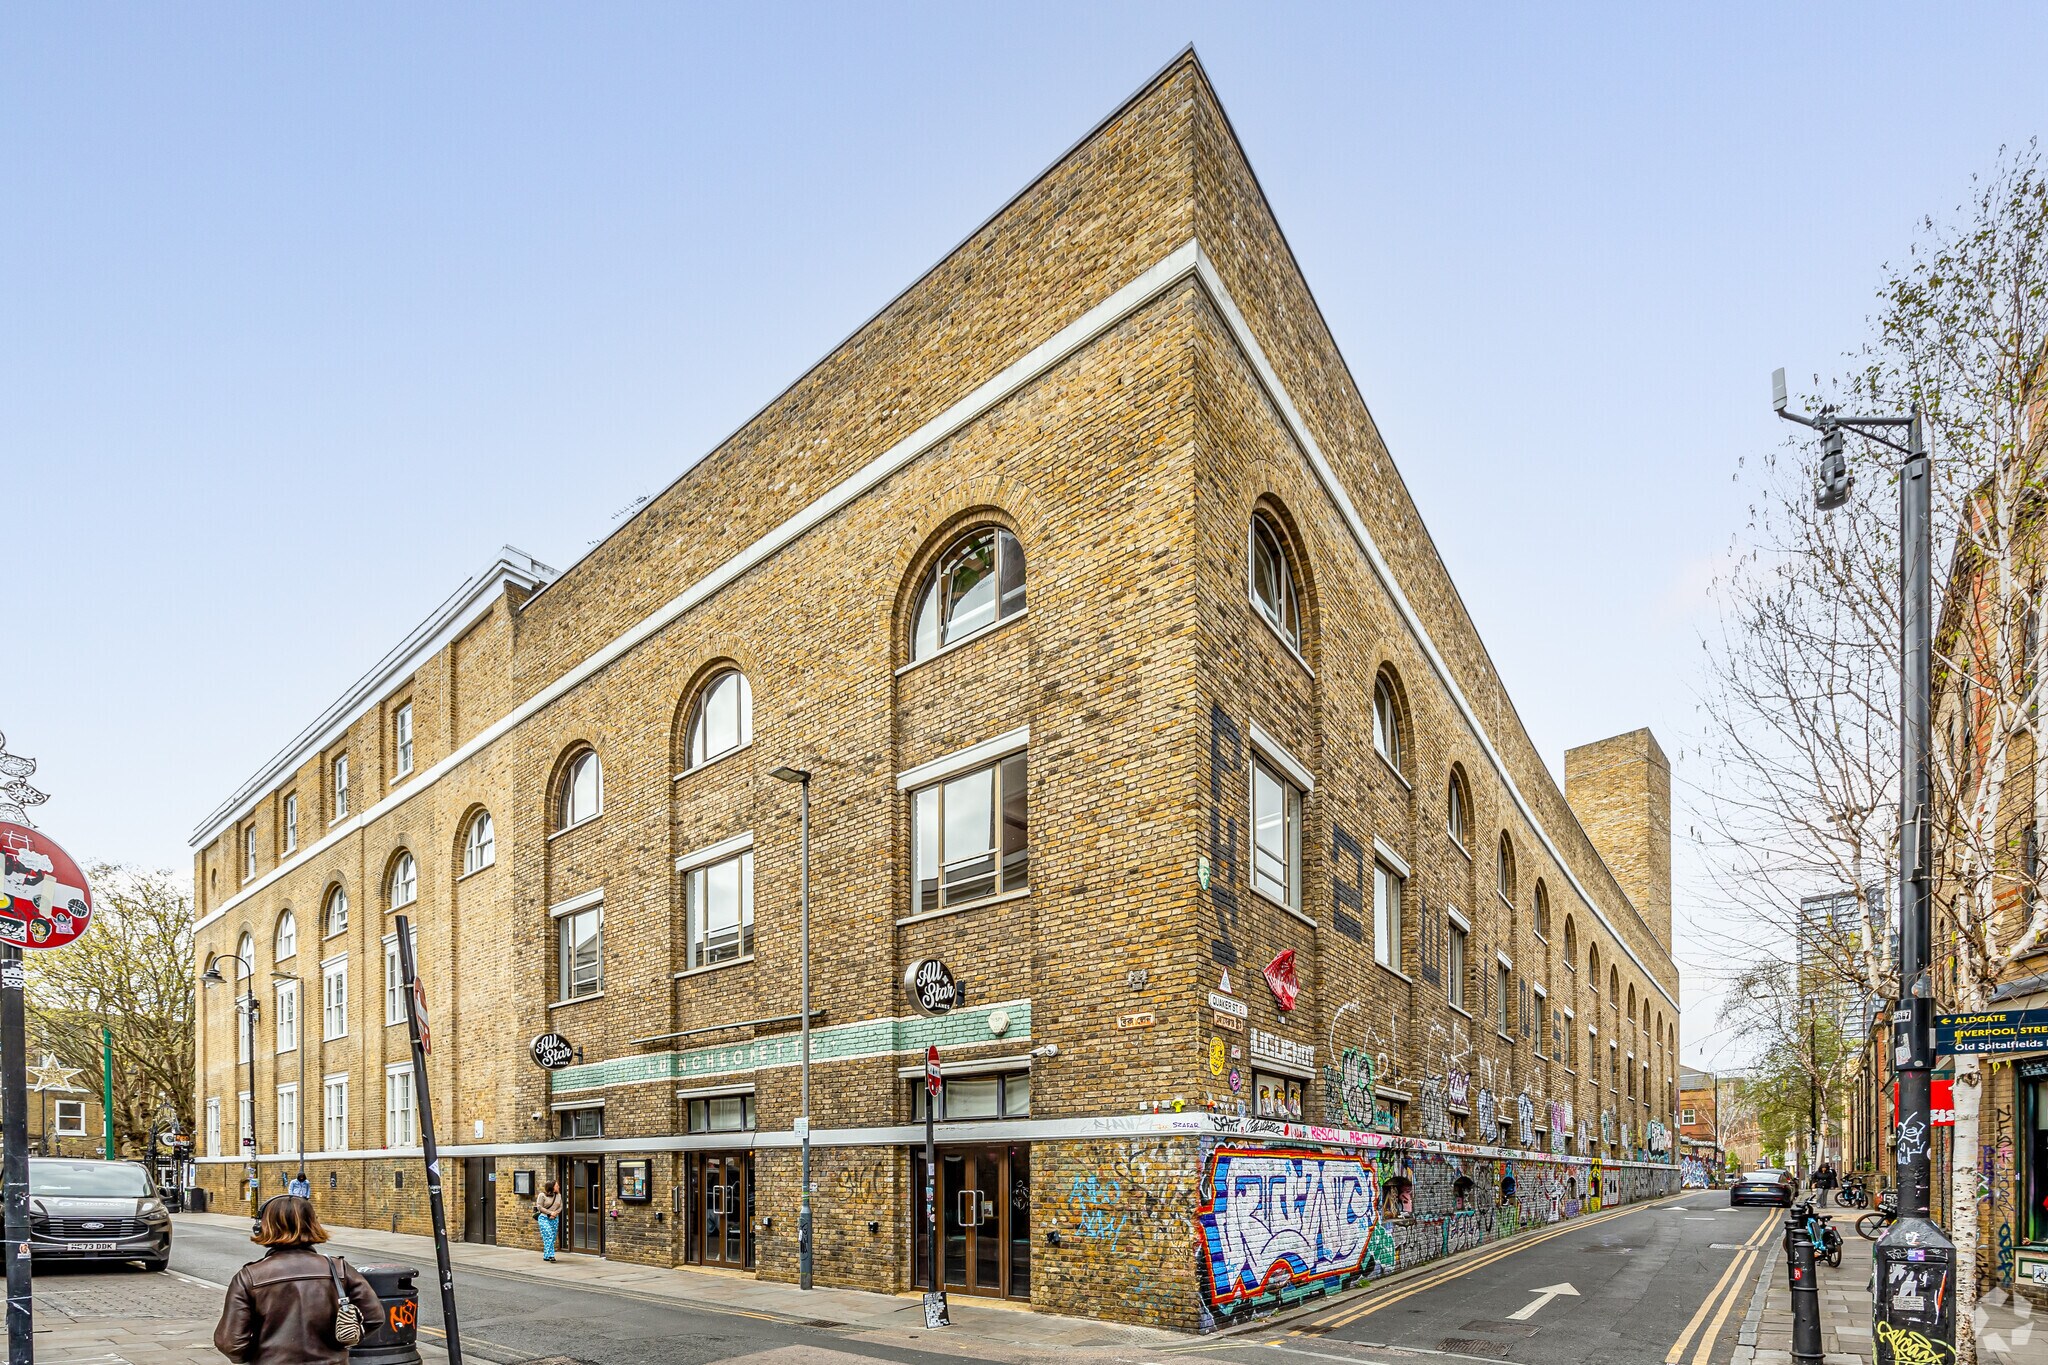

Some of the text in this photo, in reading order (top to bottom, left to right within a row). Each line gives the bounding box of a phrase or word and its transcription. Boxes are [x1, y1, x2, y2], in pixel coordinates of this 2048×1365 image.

[917, 960, 943, 987] All
[922, 982, 955, 1009] Star
[1213, 996, 1232, 1011] QUAKER
[1955, 1014, 2007, 1024] ALDGATE
[536, 1034, 560, 1054] All
[1955, 1043, 1975, 1051] Old
[1978, 1039, 2043, 1051] Spitalfields
[542, 1047, 572, 1067] Star
